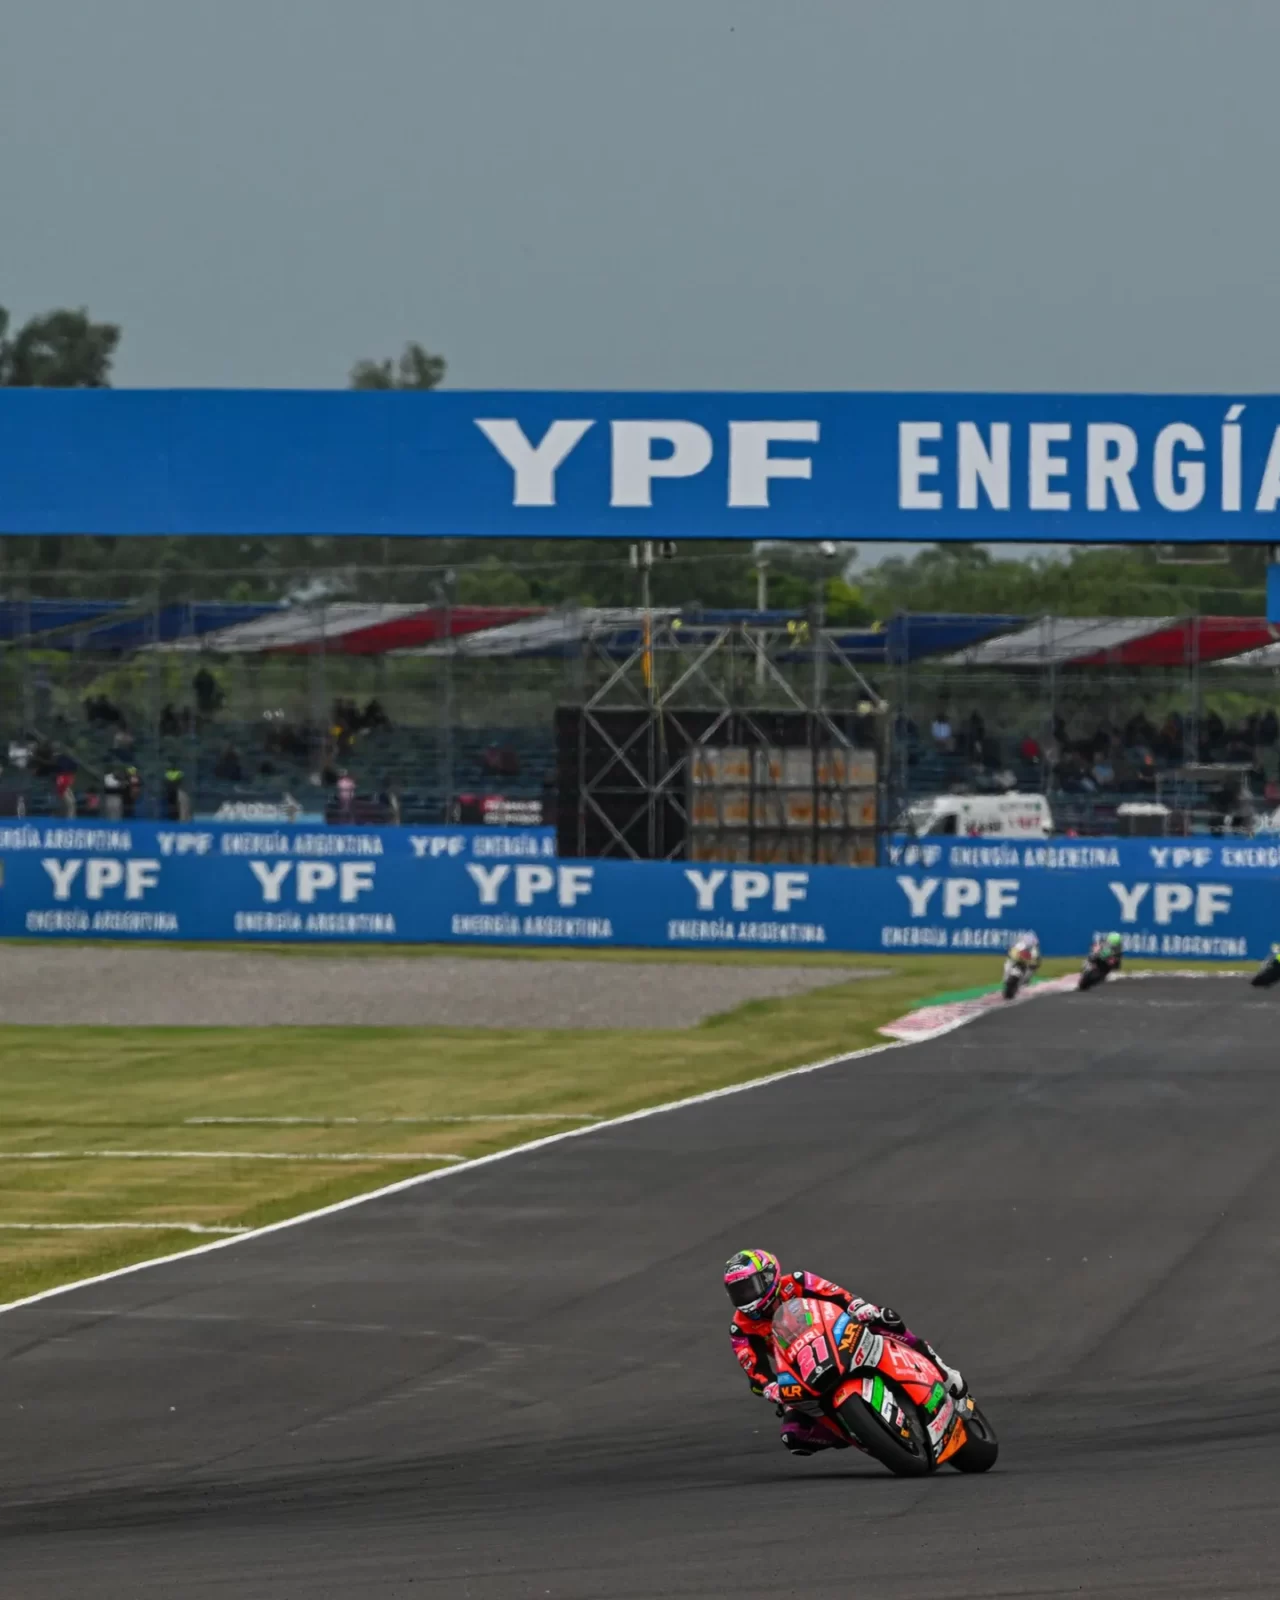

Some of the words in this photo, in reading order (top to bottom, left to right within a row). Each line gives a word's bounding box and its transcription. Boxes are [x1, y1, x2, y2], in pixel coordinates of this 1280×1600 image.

[475, 419, 820, 507] YPF
[43, 829, 131, 850] ARGENTINA
[158, 833, 212, 855] YPF
[291, 834, 383, 856] ARGENTINA
[410, 836, 464, 857] YPF
[1024, 847, 1119, 868] ARGENTINA
[1150, 847, 1212, 867] YPF
[42, 858, 160, 900] YPF
[250, 861, 375, 902] YPF
[467, 863, 594, 906] YPF
[685, 870, 809, 911] YPF
[897, 876, 1019, 918] YPF
[1109, 882, 1232, 925] YPF
[92, 911, 178, 932] ARGENTINA
[305, 913, 395, 933] ARGENTINA
[523, 916, 612, 937] ARGENTINA
[737, 922, 825, 942] ARGENTINA
[951, 927, 1035, 949] ARGENTIN
[1161, 935, 1246, 956] ARGENTINA
[796, 1335, 829, 1382] 21
